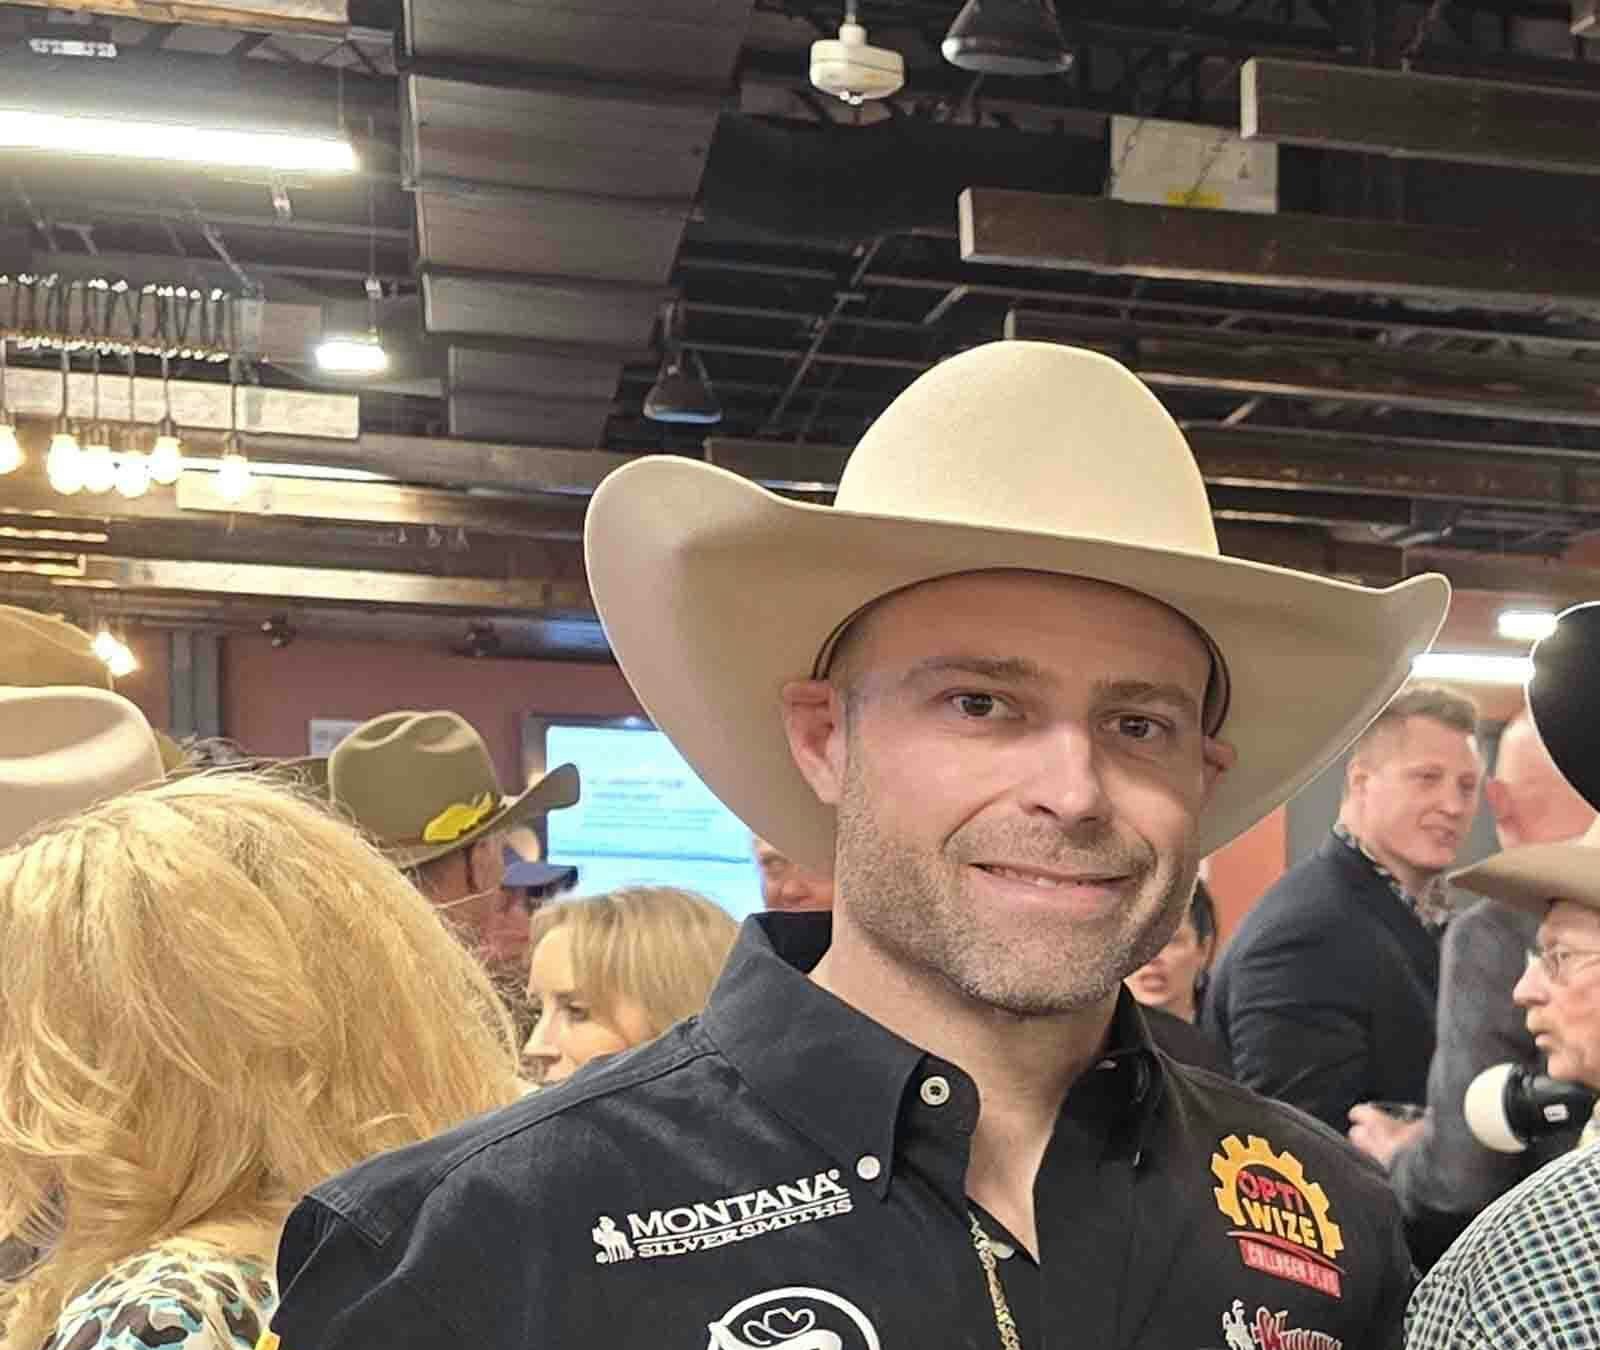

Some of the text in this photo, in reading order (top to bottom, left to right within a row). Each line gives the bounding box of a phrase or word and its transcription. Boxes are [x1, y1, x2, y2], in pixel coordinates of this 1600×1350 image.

[627, 1172, 848, 1238] MONTANA
[1239, 1171, 1305, 1213] OPTI
[635, 1199, 852, 1257] SILVERSMITHS
[1242, 1198, 1318, 1248] WIZE
